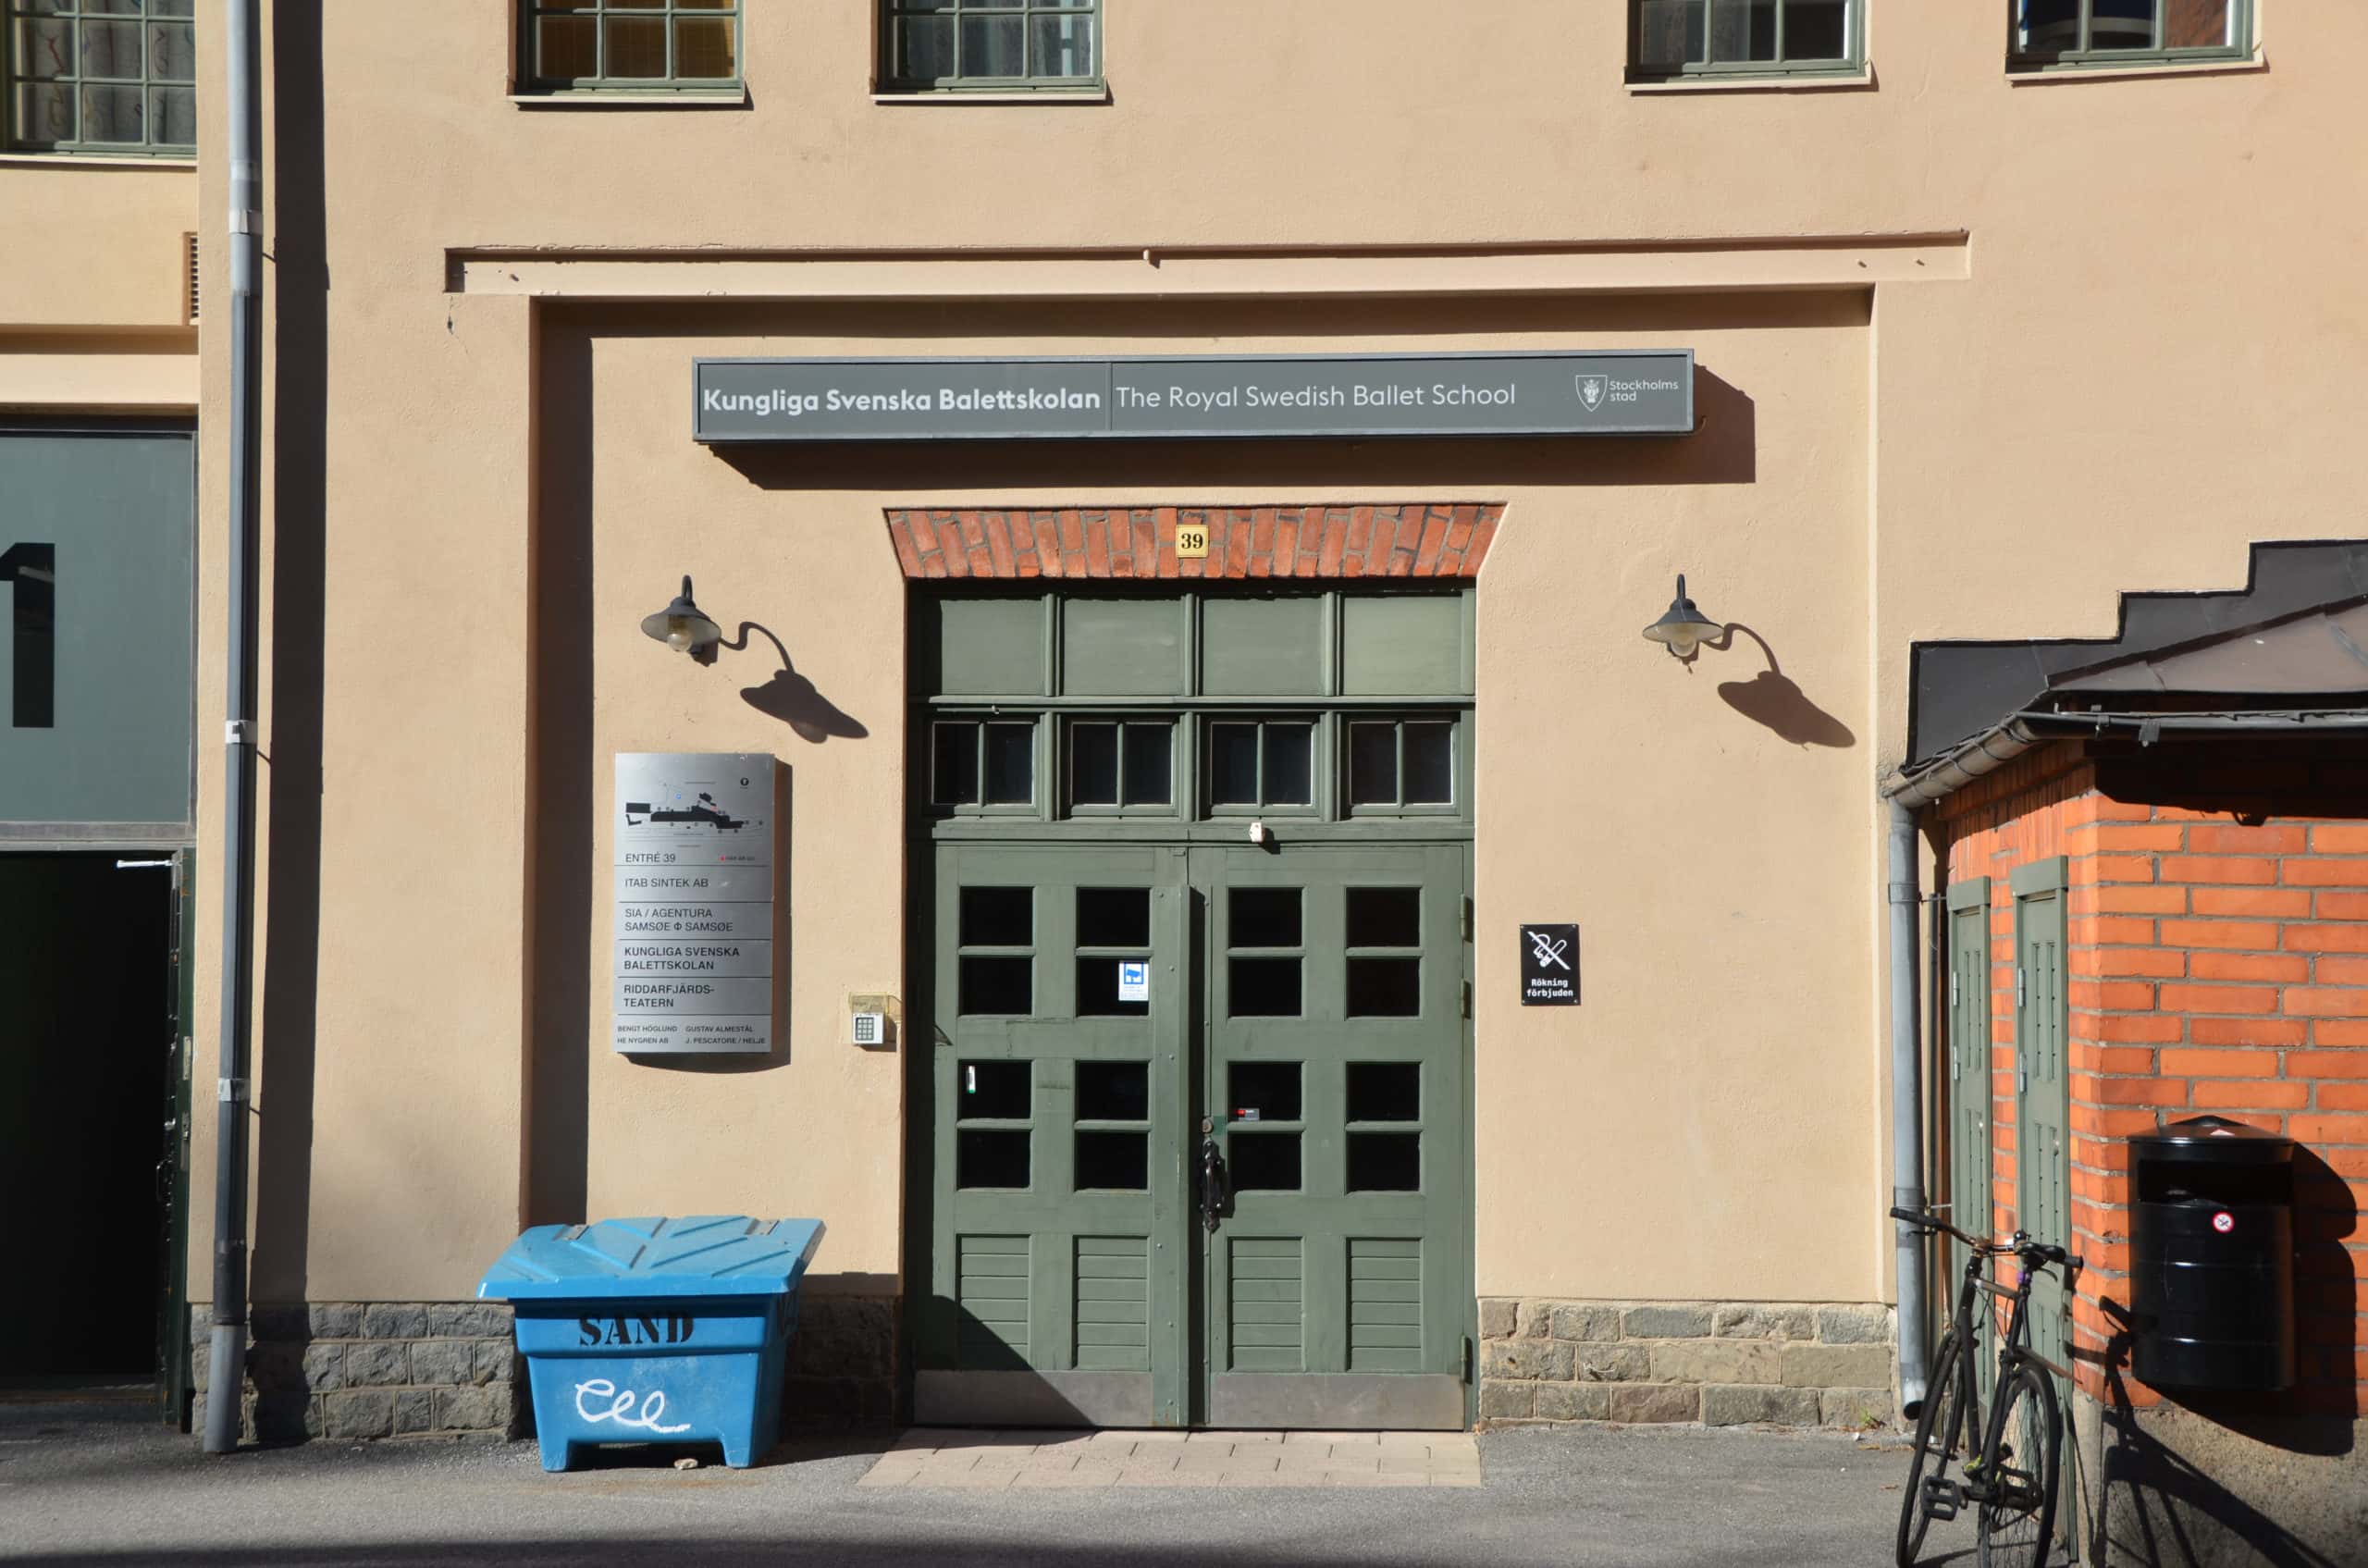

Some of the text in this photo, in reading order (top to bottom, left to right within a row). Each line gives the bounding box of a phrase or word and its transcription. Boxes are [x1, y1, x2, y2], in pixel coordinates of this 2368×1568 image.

[1610, 379, 1679, 390] Stockholms
[1116, 382, 1516, 413] The Royal Swedish Ballet School
[1610, 391, 1637, 401] stad
[703, 388, 1101, 416] Kungliga Svenska Balettskolan
[1181, 533, 1203, 549] 39
[625, 852, 676, 863] ENTRÉ 39
[624, 878, 709, 888] ITAB SINTEK AB
[624, 908, 642, 918] SIA
[651, 908, 713, 918] AGENTURA
[624, 947, 740, 957] KUNGLIGA SVENSKA
[623, 960, 714, 970] BALETTSKOLAN
[623, 982, 715, 994] RIDDARFJÄRDS-
[1531, 978, 1568, 988] Rökning
[1526, 988, 1573, 998] förbjuden
[623, 998, 674, 1007] TEATERN
[578, 1312, 694, 1346] SAND
